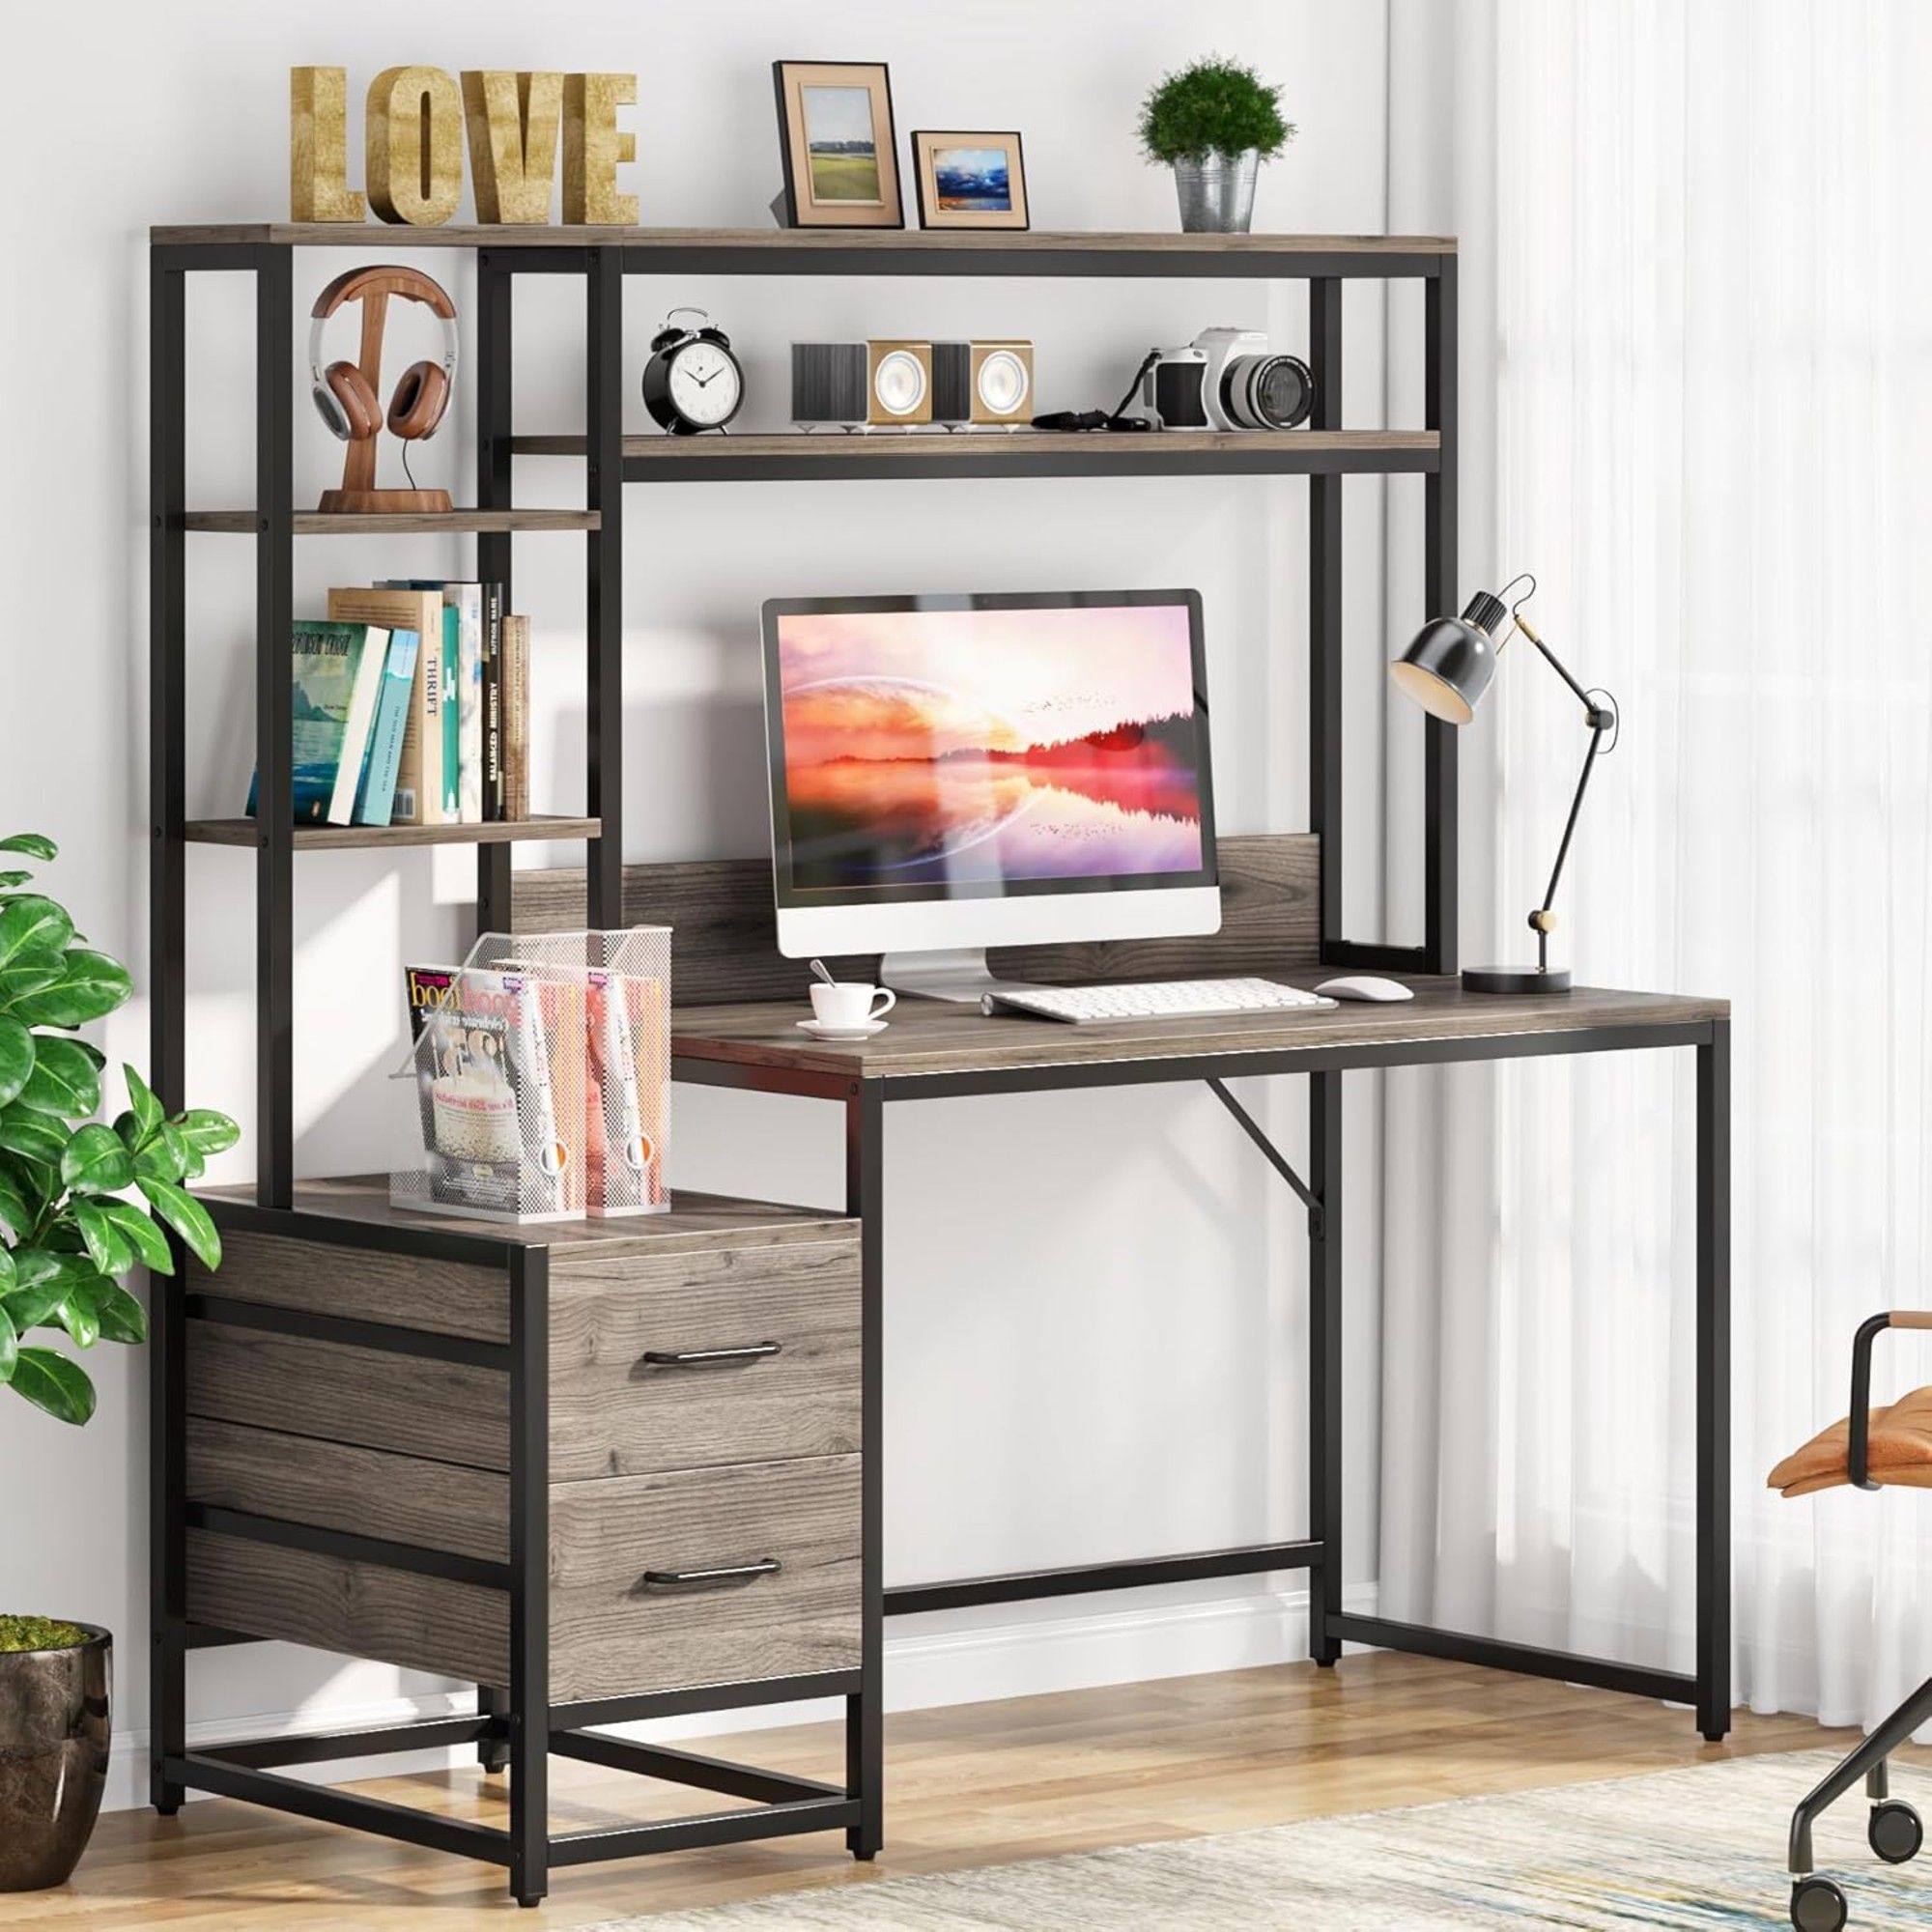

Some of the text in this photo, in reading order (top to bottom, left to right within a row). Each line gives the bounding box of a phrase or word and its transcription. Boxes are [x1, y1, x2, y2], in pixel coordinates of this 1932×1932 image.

[291, 65, 639, 225] LOVE
[427, 657, 438, 717] THRIFT
[489, 682, 497, 781] BALANCED MINISTRY
